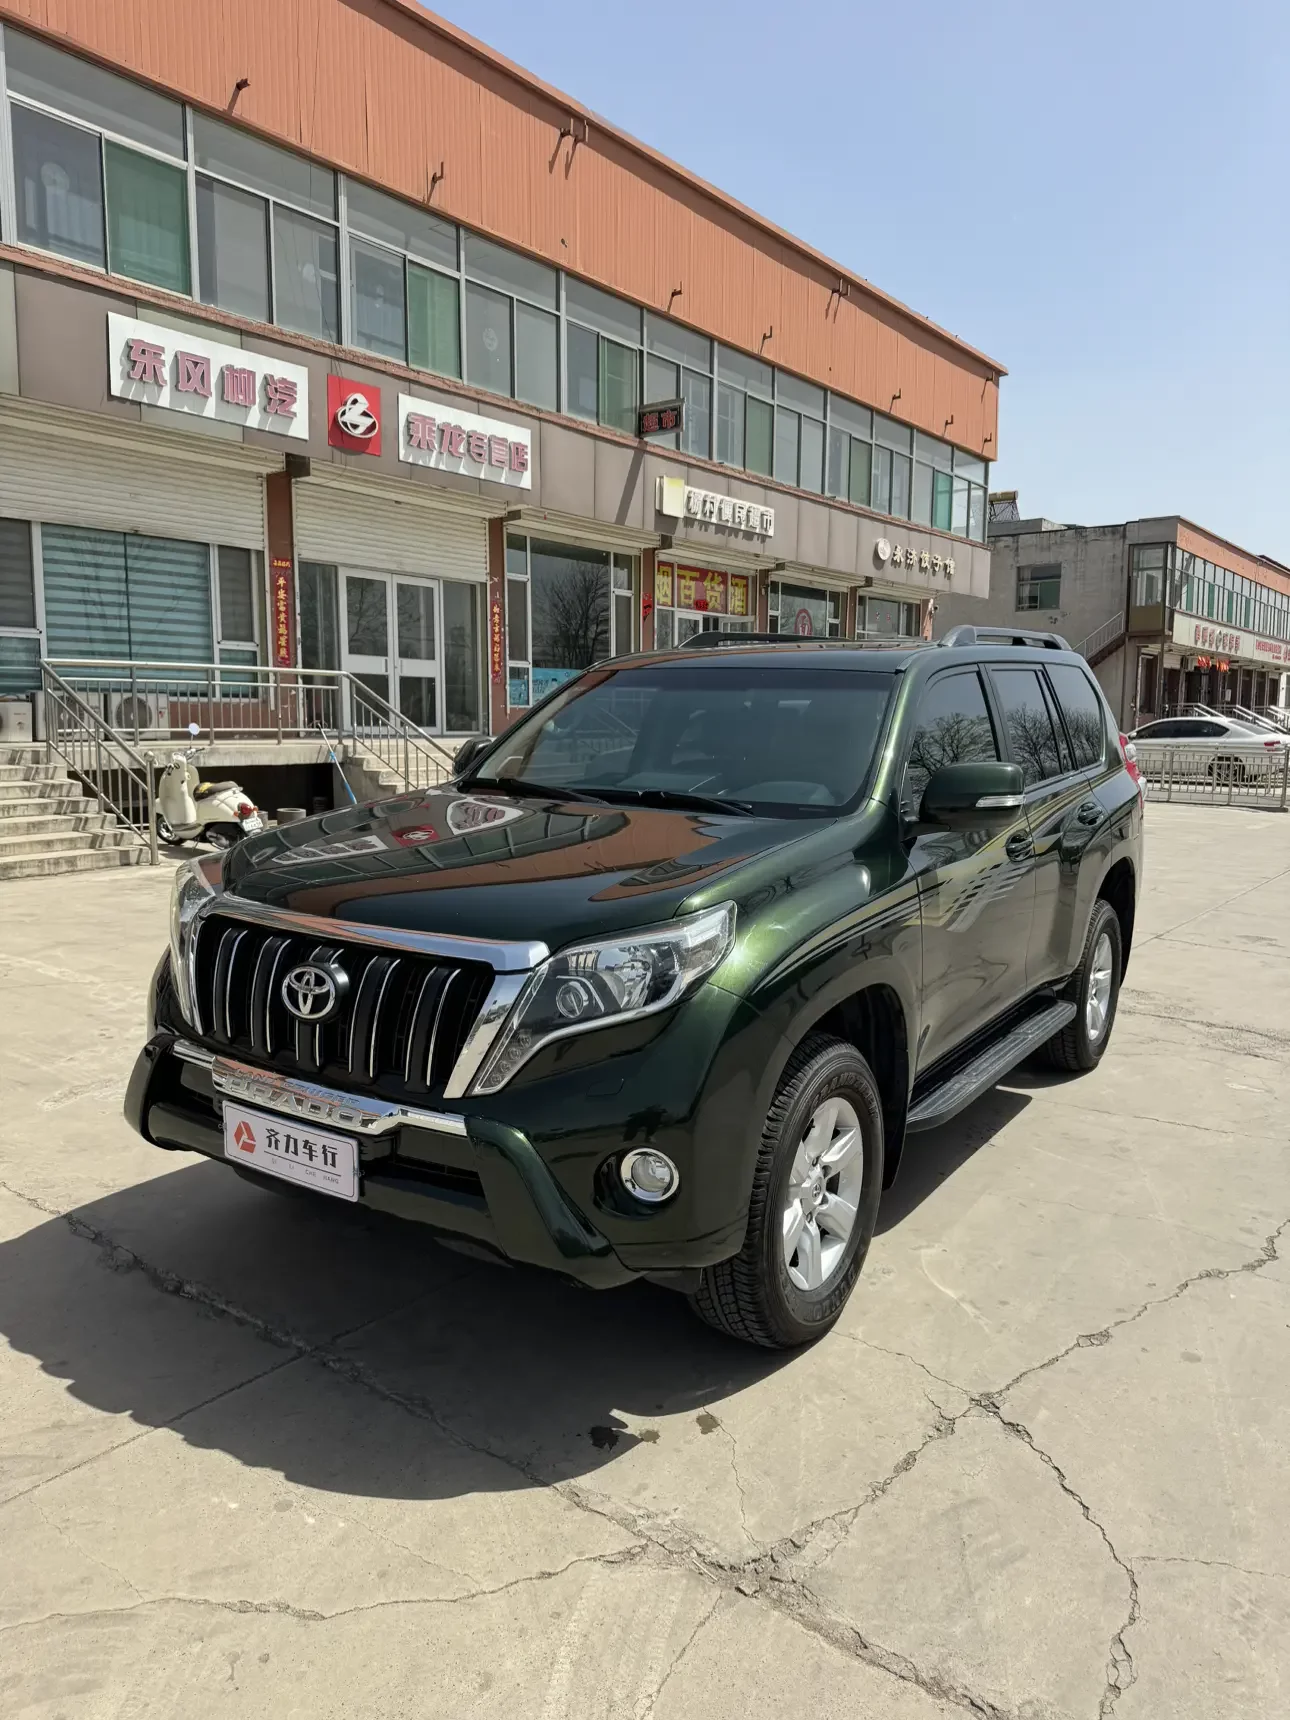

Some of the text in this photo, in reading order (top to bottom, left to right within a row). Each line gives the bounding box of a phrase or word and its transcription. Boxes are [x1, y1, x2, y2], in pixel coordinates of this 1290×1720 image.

[127, 338, 298, 418] 东风柳汽
[408, 412, 529, 473] 乘龙专营店
[642, 409, 677, 432] 超市
[225, 1076, 362, 1126] PRADO
[265, 1128, 338, 1168] 齐力车行
